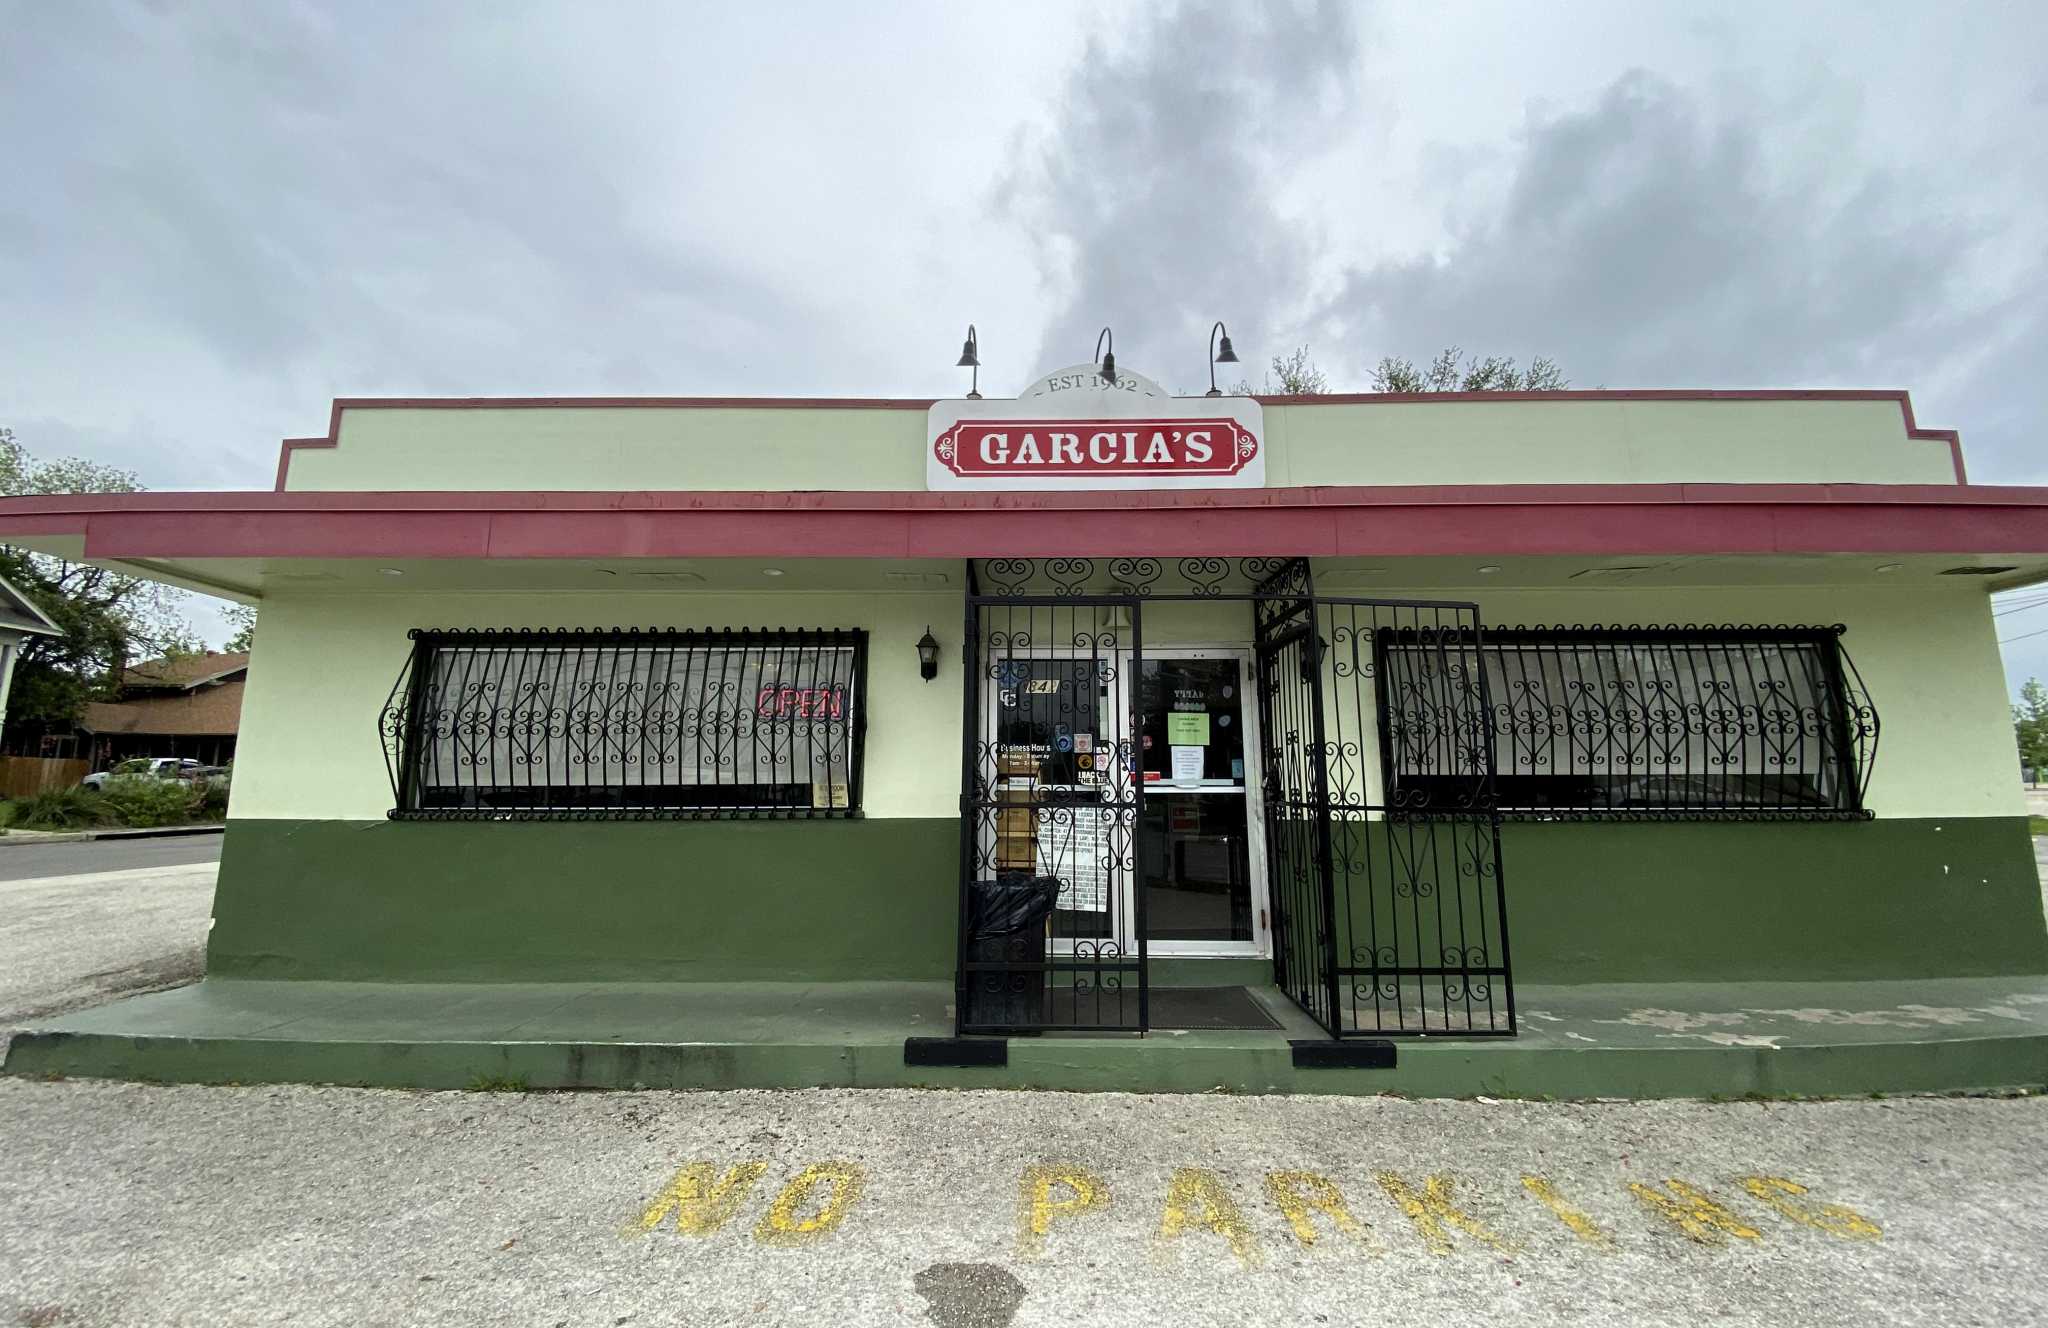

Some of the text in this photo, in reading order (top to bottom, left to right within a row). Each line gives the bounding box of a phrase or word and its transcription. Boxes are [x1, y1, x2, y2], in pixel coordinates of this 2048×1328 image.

[1048, 375, 1083, 392] EST
[979, 431, 1213, 464] GARCIA'S
[757, 688, 843, 718] OPEN
[1031, 744, 1051, 752] Hous
[632, 1160, 867, 1245] NO
